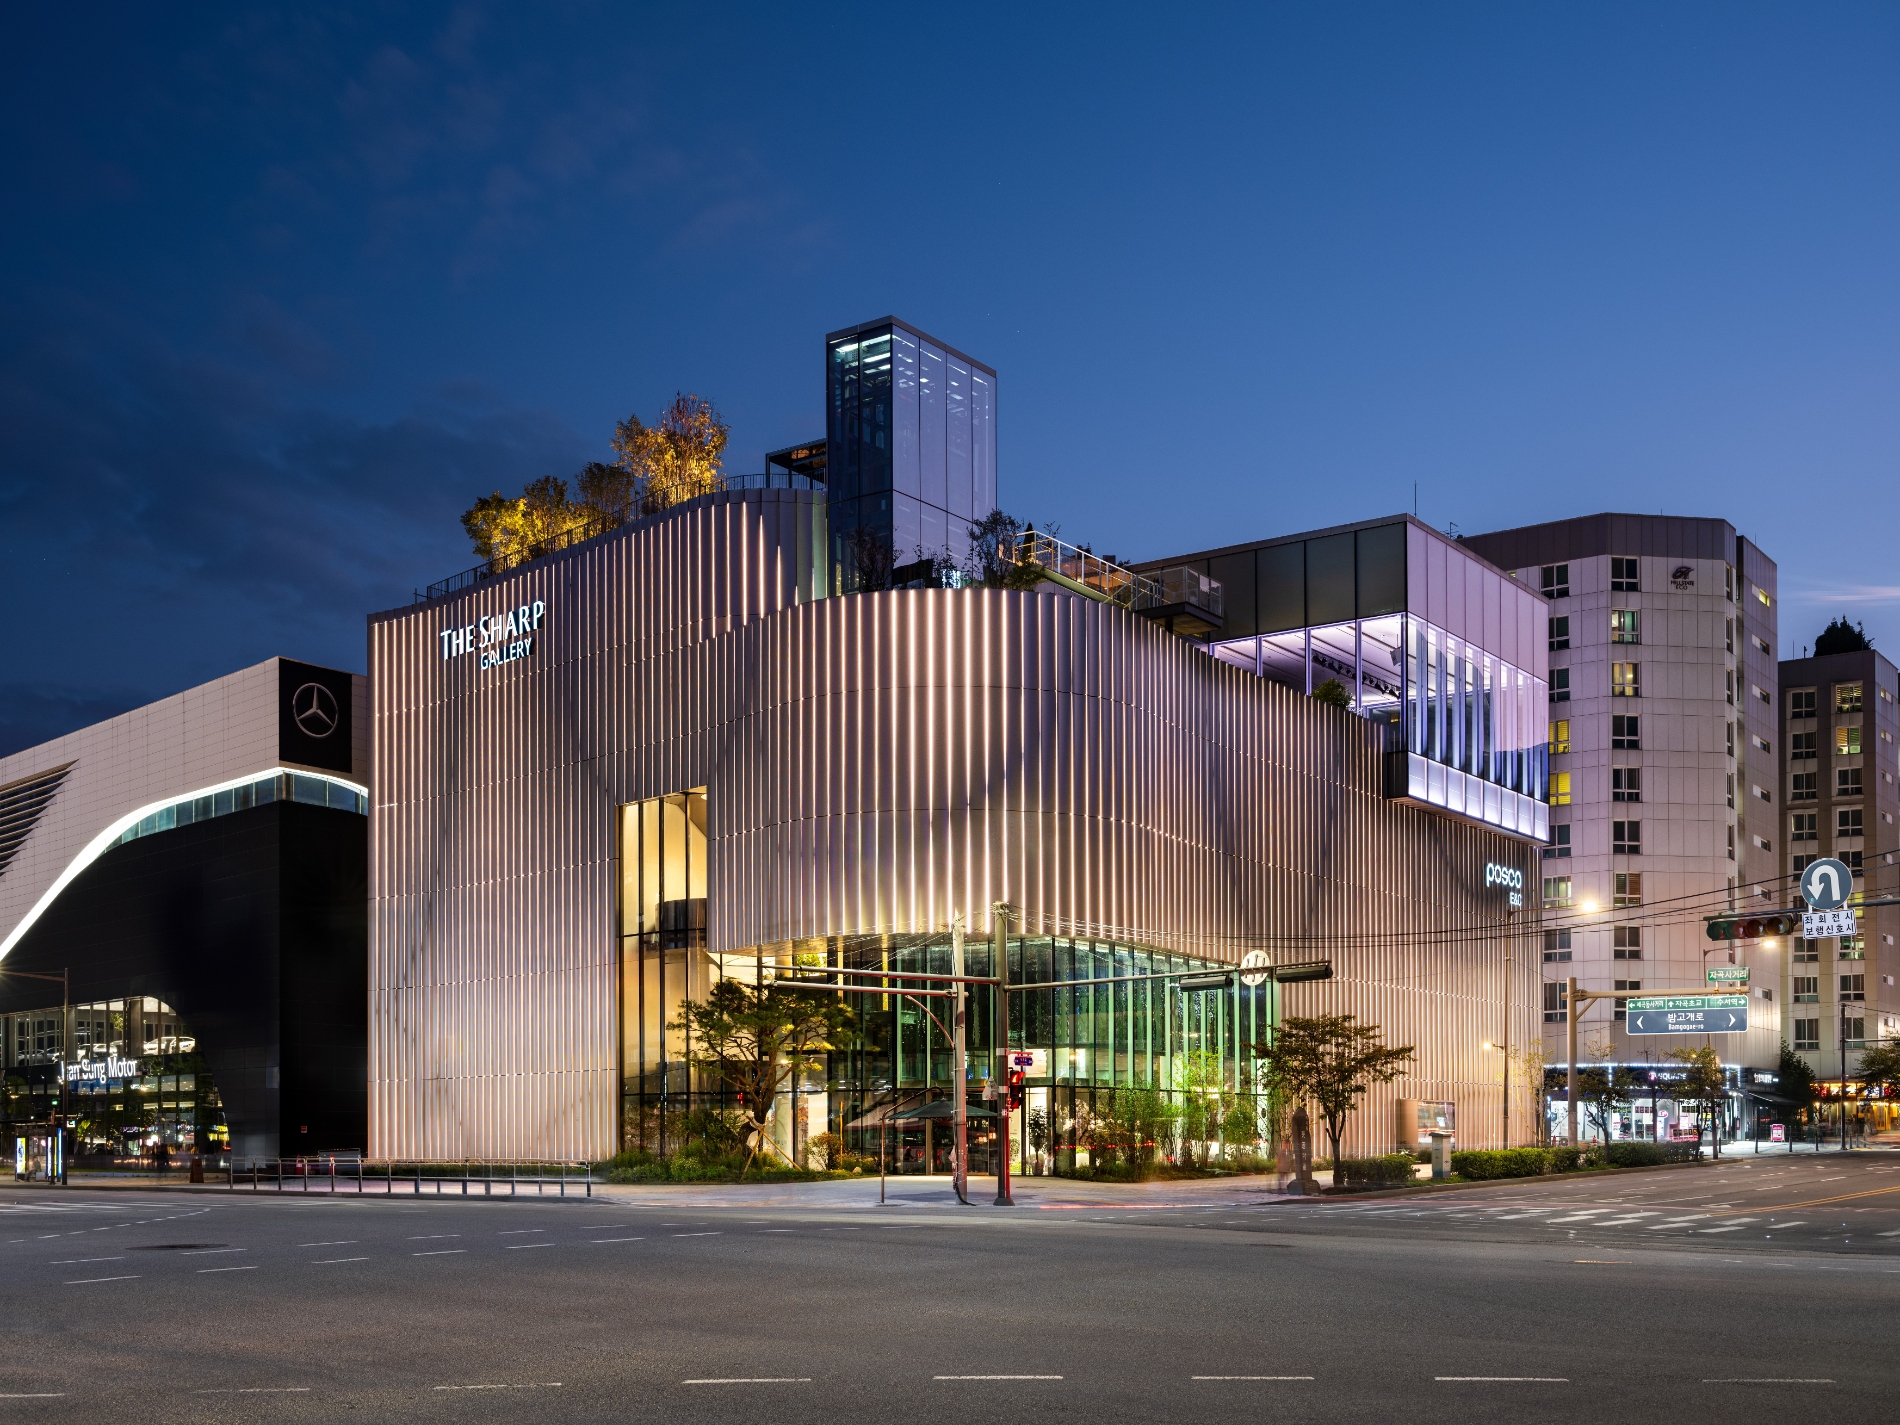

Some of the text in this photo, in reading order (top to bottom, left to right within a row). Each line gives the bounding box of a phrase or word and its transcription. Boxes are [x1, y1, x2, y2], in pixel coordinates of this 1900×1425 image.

[440, 600, 545, 660] THE SHARP
[480, 637, 532, 670] GALLERY
[1486, 862, 1522, 889] posco
[1509, 891, 1522, 907] E&C
[1805, 923, 1854, 936] 보행신호시
[1709, 969, 1747, 979] 자곡사거리
[1675, 999, 1703, 1008] 자곡초교
[1716, 997, 1738, 1006] 수서역
[1667, 1012, 1705, 1023] 밤고개로
[81, 1058, 107, 1084] Sung
[108, 1056, 138, 1078] Motor
